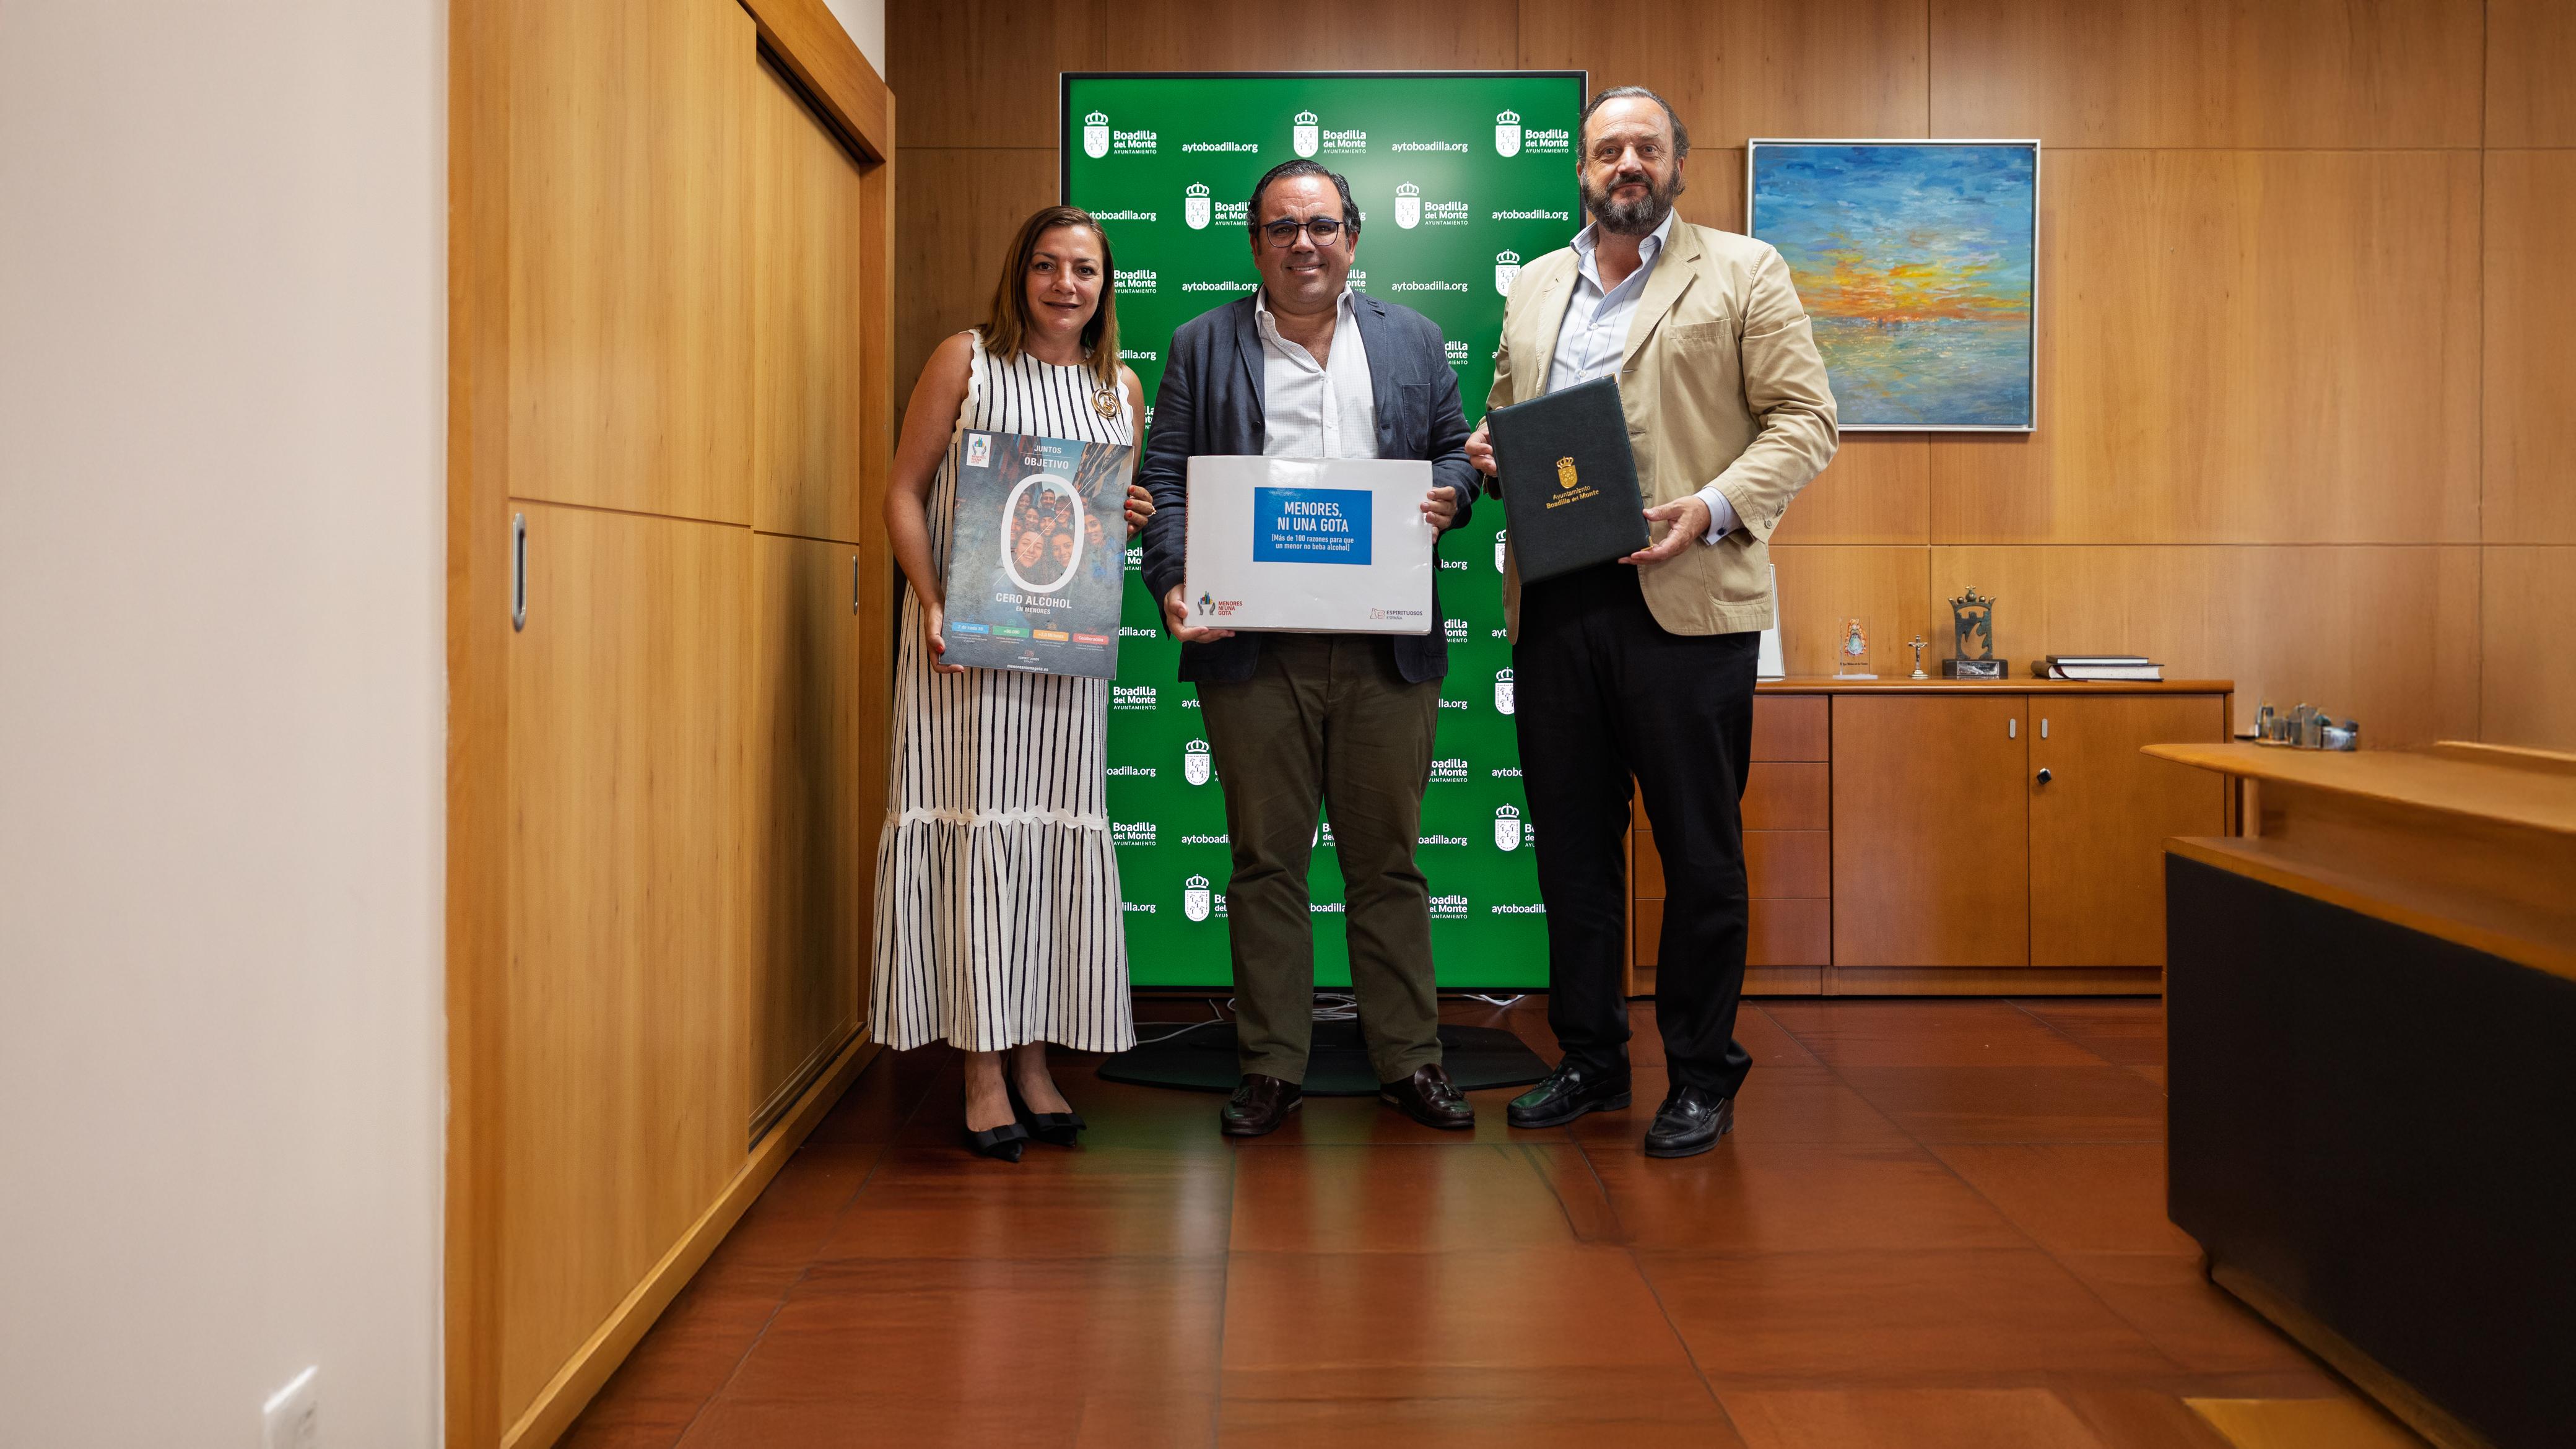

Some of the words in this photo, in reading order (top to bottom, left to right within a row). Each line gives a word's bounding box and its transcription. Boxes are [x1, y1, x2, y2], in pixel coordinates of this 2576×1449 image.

[1114, 131, 1156, 141] Boadilla
[1323, 130, 1366, 140] Boadilla
[1526, 129, 1569, 139] Boadilla
[1128, 140, 1156, 148] Monte
[1182, 142, 1258, 153] aytoboadilla.org
[1338, 139, 1366, 147] Monte
[1392, 141, 1468, 152] aytoboadilla.org
[1540, 139, 1569, 147] Monte
[1215, 202, 1250, 211] Boadil
[1425, 201, 1468, 212] Boadilla
[1090, 211, 1156, 221] toboadilla.org
[1492, 209, 1568, 220] aytoboadilla.org
[1114, 270, 1156, 280] Boadilla
[1128, 279, 1156, 287] Monte
[1182, 281, 1258, 292] aytoboadilla.org
[1392, 281, 1468, 292] aytoboadilla.org
[1445, 341, 1468, 350] dilla
[1034, 445, 1061, 454] JUNTOS
[1024, 457, 1069, 469] OBJETIVO
[1553, 485, 1591, 500] Ayuntamiento
[1546, 498, 1570, 509] Boadilla
[1579, 490, 1599, 500] Monte
[1285, 502, 1342, 518] MENORES,
[1277, 517, 1289, 530] NI
[1293, 517, 1316, 531] UNA
[1320, 519, 1349, 532] GOTA
[1272, 534, 1285, 542] [Más
[1327, 544, 1350, 552] alcohol]
[996, 593, 1022, 604] CERO
[1025, 596, 1073, 609] ALCOHOL
[1445, 619, 1468, 628] dilla
[1119, 627, 1156, 638] dilla.org
[1113, 686, 1155, 697] Boadilla
[1432, 759, 1468, 768] oadilla
[1107, 766, 1156, 777] oadilla.org
[1113, 822, 1155, 832] Boadilla
[1128, 832, 1155, 840] Monte
[1418, 835, 1468, 846] oadilla.org
[1438, 905, 1468, 913] Monte
[1492, 904, 1546, 914] aytoboadill
